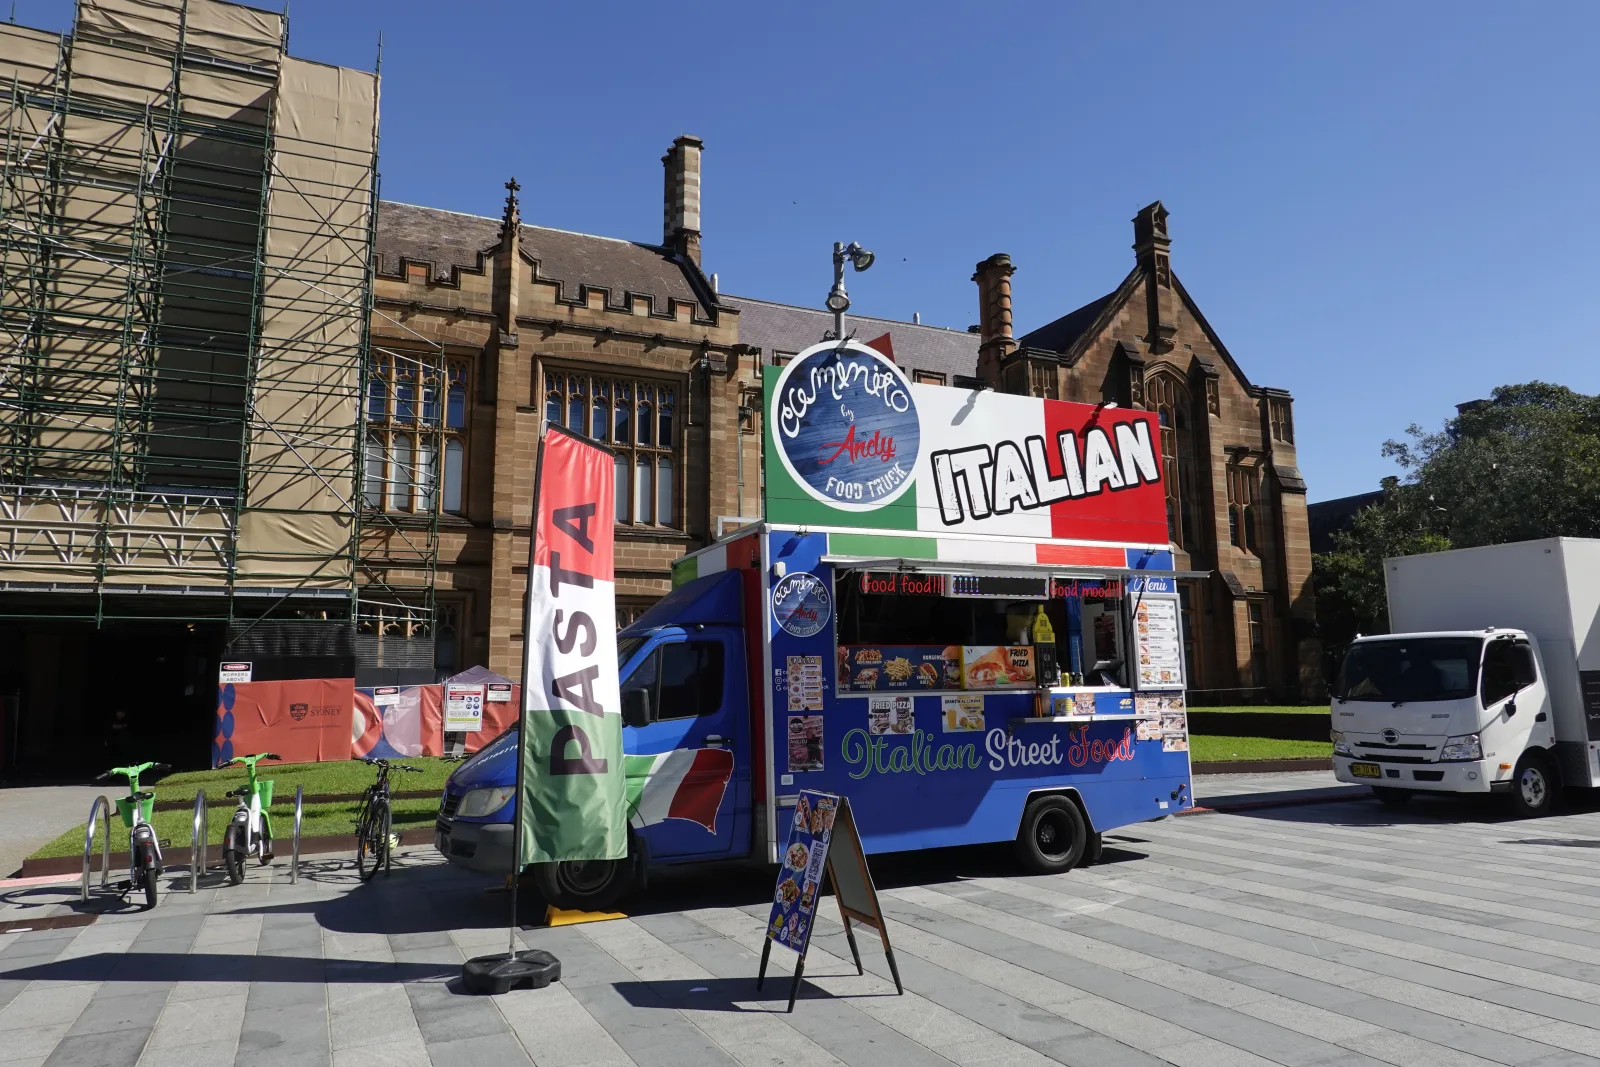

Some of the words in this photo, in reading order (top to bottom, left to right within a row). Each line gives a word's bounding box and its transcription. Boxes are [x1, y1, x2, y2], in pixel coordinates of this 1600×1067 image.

[840, 404, 855, 421] by
[818, 424, 897, 465] Andy
[826, 477, 863, 500] FOOD
[868, 461, 908, 497] TRUCK
[931, 419, 1161, 525] ITALIAN
[861, 573, 896, 593] Good
[1050, 578, 1078, 598] Good
[550, 502, 608, 776] PASTA
[1009, 649, 1028, 657] FRIED
[1012, 659, 1029, 667] PIZZA
[310, 708, 342, 717] SYDNEY
[871, 700, 891, 710] FRIED
[891, 700, 912, 710] PIZZA
[841, 728, 982, 779] Italian
[985, 728, 1063, 771] Street
[1068, 725, 1135, 768] Food
